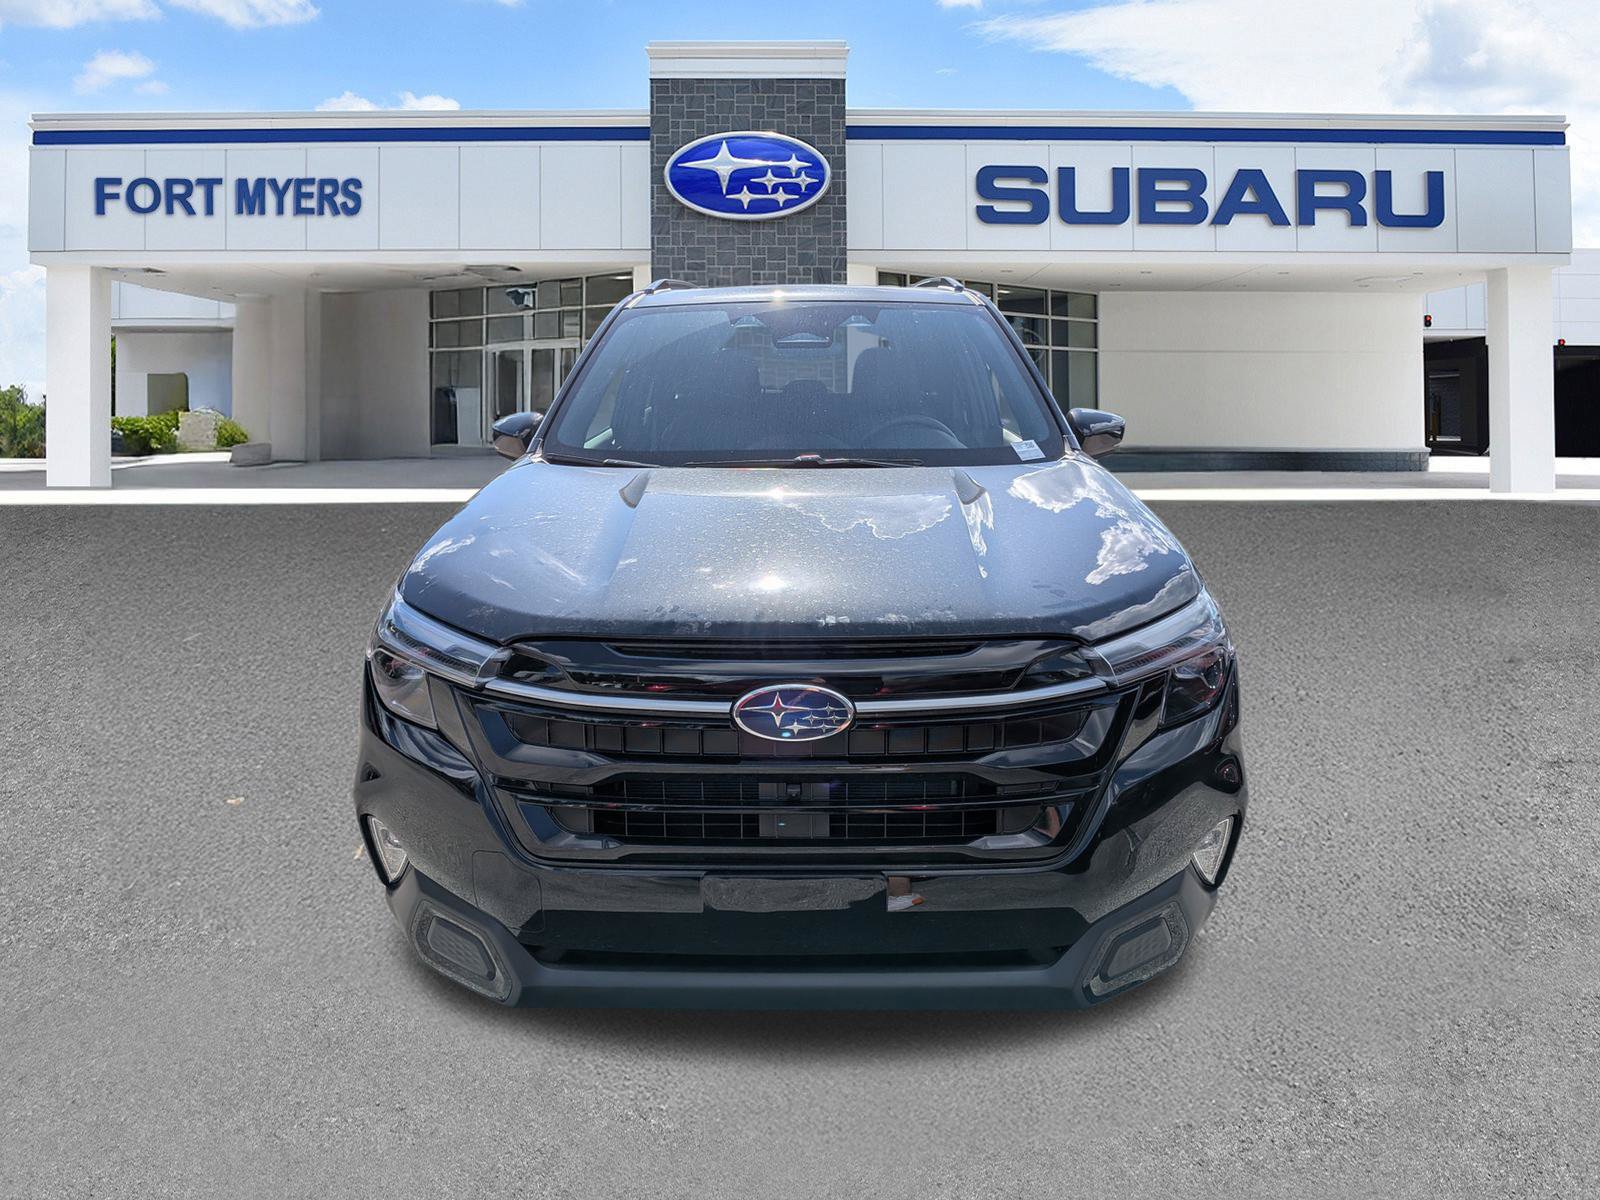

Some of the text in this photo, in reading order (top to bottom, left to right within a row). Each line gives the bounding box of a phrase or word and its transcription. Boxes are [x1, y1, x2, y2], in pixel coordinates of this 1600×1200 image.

[94, 177, 362, 216] FORT MYERS
[976, 165, 1445, 227] SUBARU
